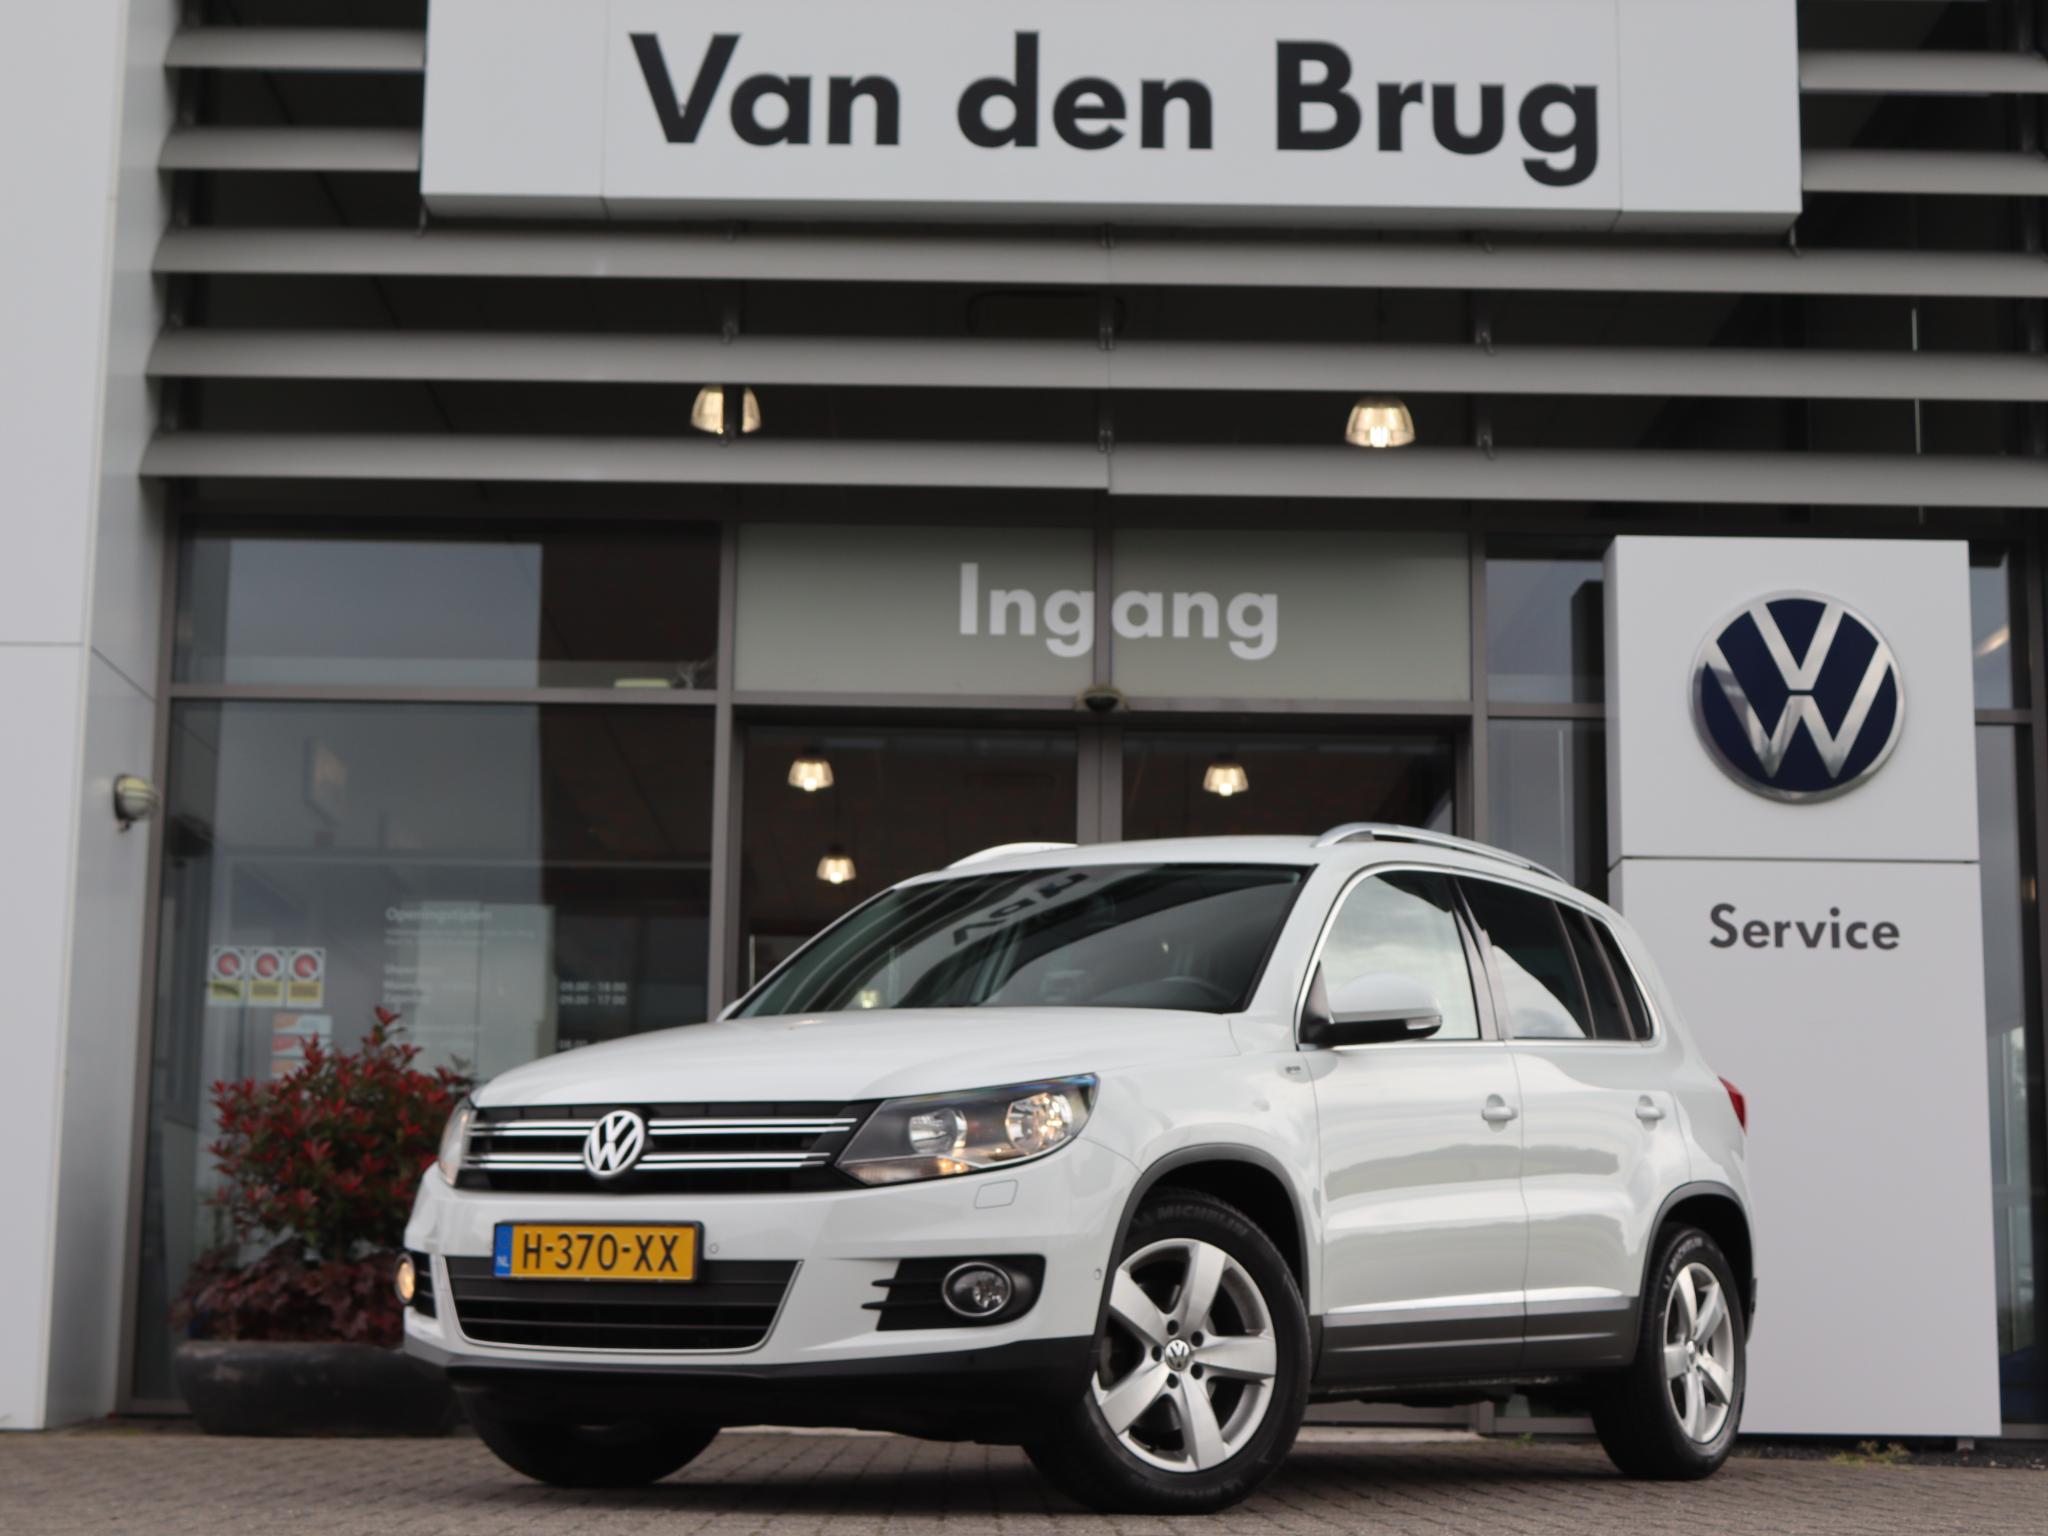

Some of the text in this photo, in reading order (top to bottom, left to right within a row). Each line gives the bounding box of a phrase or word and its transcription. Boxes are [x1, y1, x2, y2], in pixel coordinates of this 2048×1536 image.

[629, 30, 1600, 188] Van den Brug
[960, 562, 1279, 661] Ingang
[1709, 902, 1901, 951] Service
[522, 1232, 680, 1273] H-370-XX
